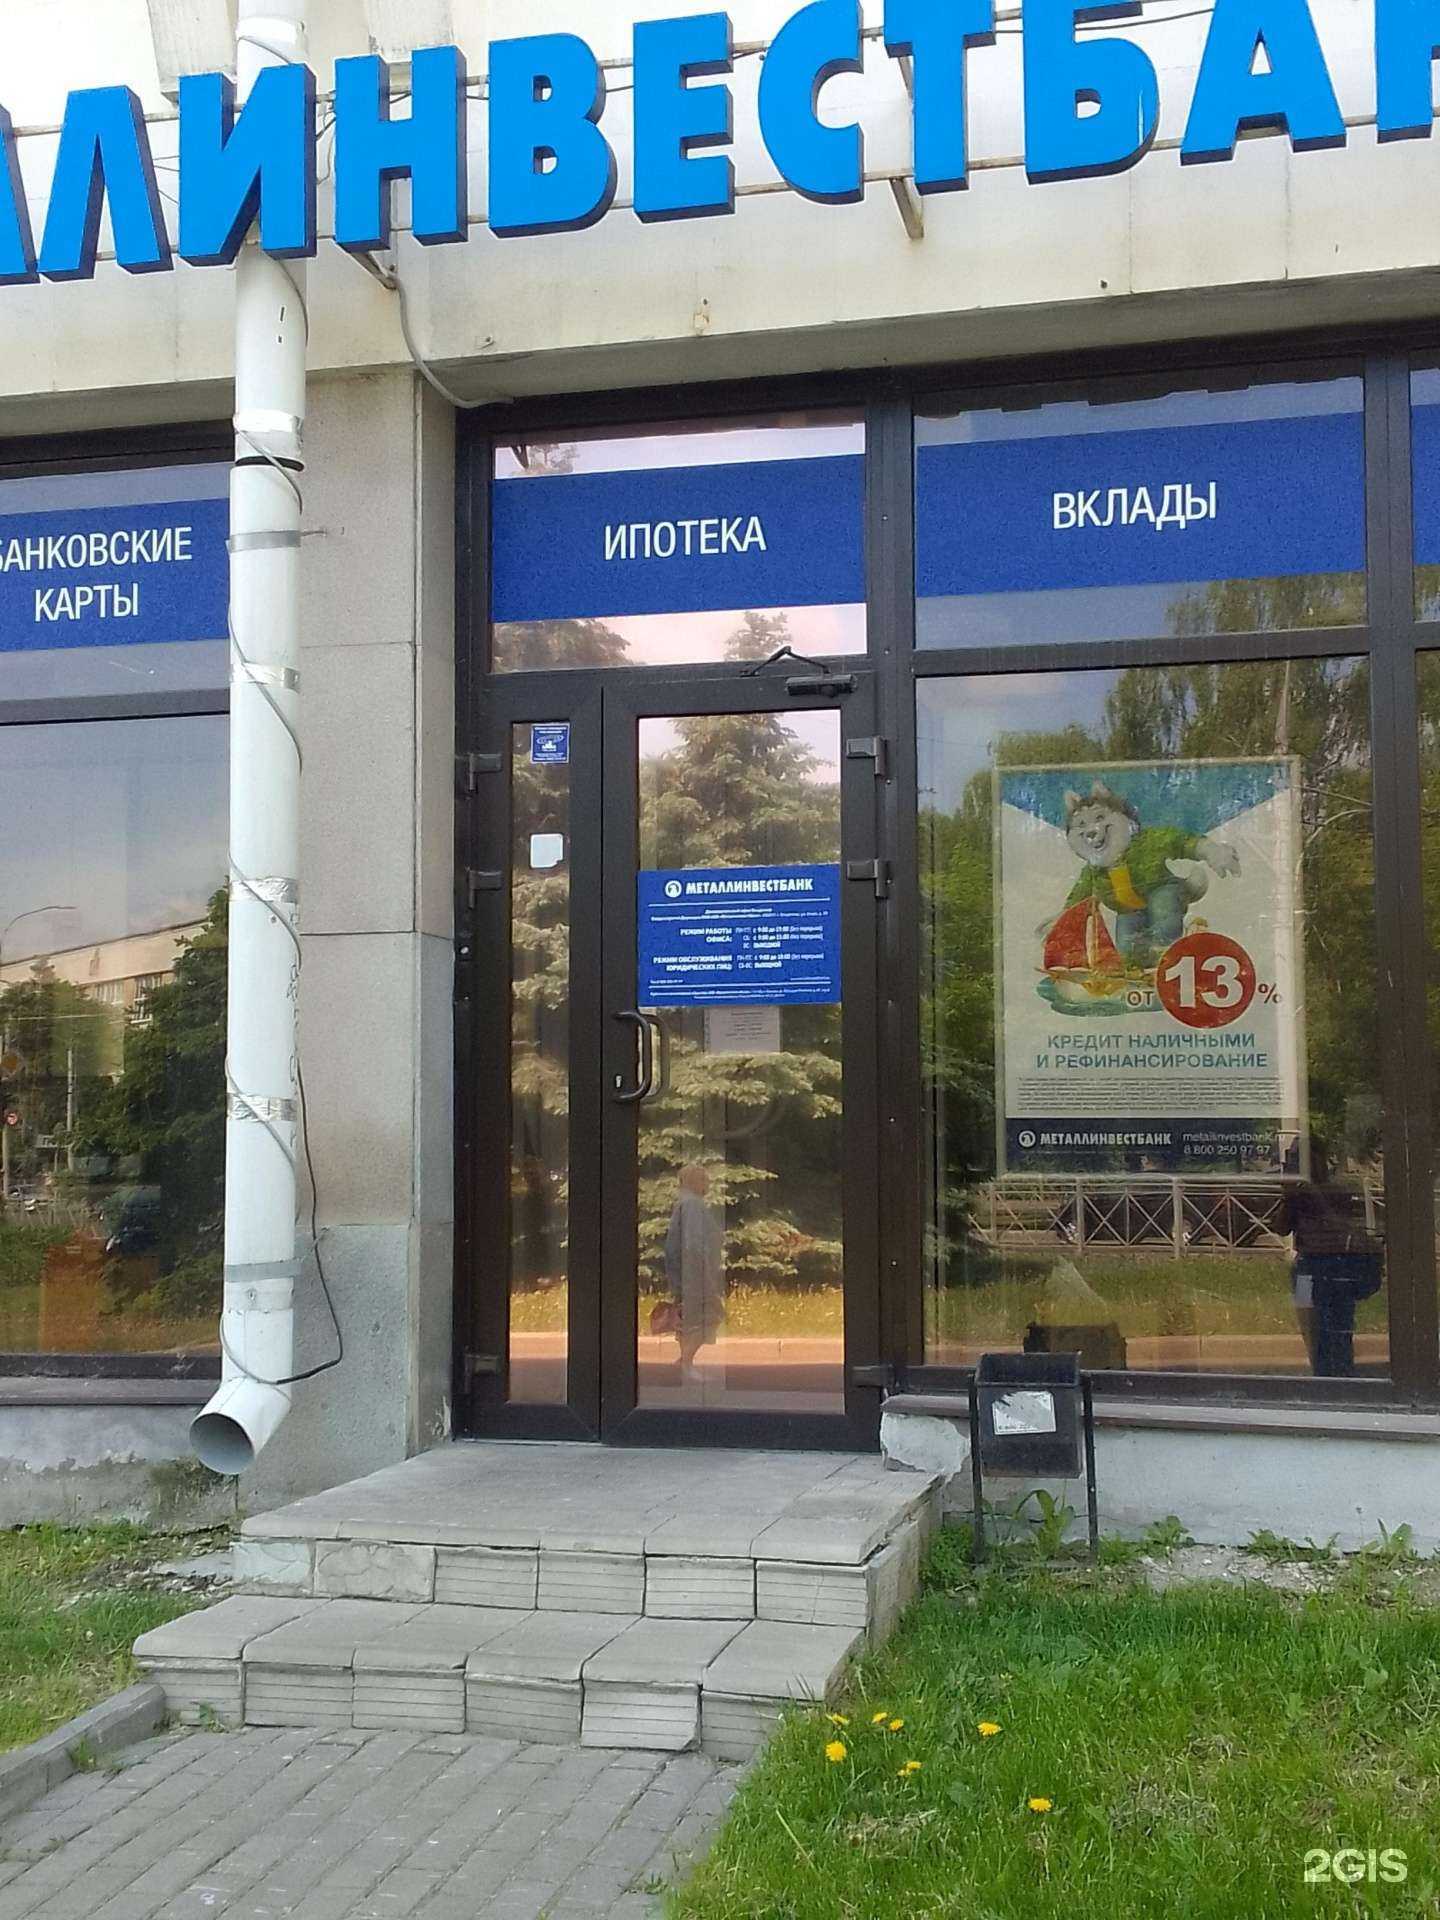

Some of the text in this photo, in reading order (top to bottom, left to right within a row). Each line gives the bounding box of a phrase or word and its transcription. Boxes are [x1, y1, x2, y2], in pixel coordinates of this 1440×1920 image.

[1053, 482, 1217, 531] ВКЛАДЫ
[605, 516, 767, 560] ИПОТЕКА
[34, 583, 139, 622] КАРТЫ
[685, 878, 814, 895] МЕТАЛЛИНВЕСТБАНК
[1127, 955, 1282, 1009] ОТ 13 %
[1047, 1033, 1256, 1051] КРЕДИТ НАЛИЧНЫМИ
[1036, 1053, 1268, 1068] И РЕФИНАНСИРОВАНИЕ
[1040, 1132, 1172, 1145] МЕТАЛЛИНВЕСТБАНК
[1183, 1144, 1192, 1154] 8
[1193, 1144, 1215, 1155] 800
[1217, 1144, 1238, 1155] 250
